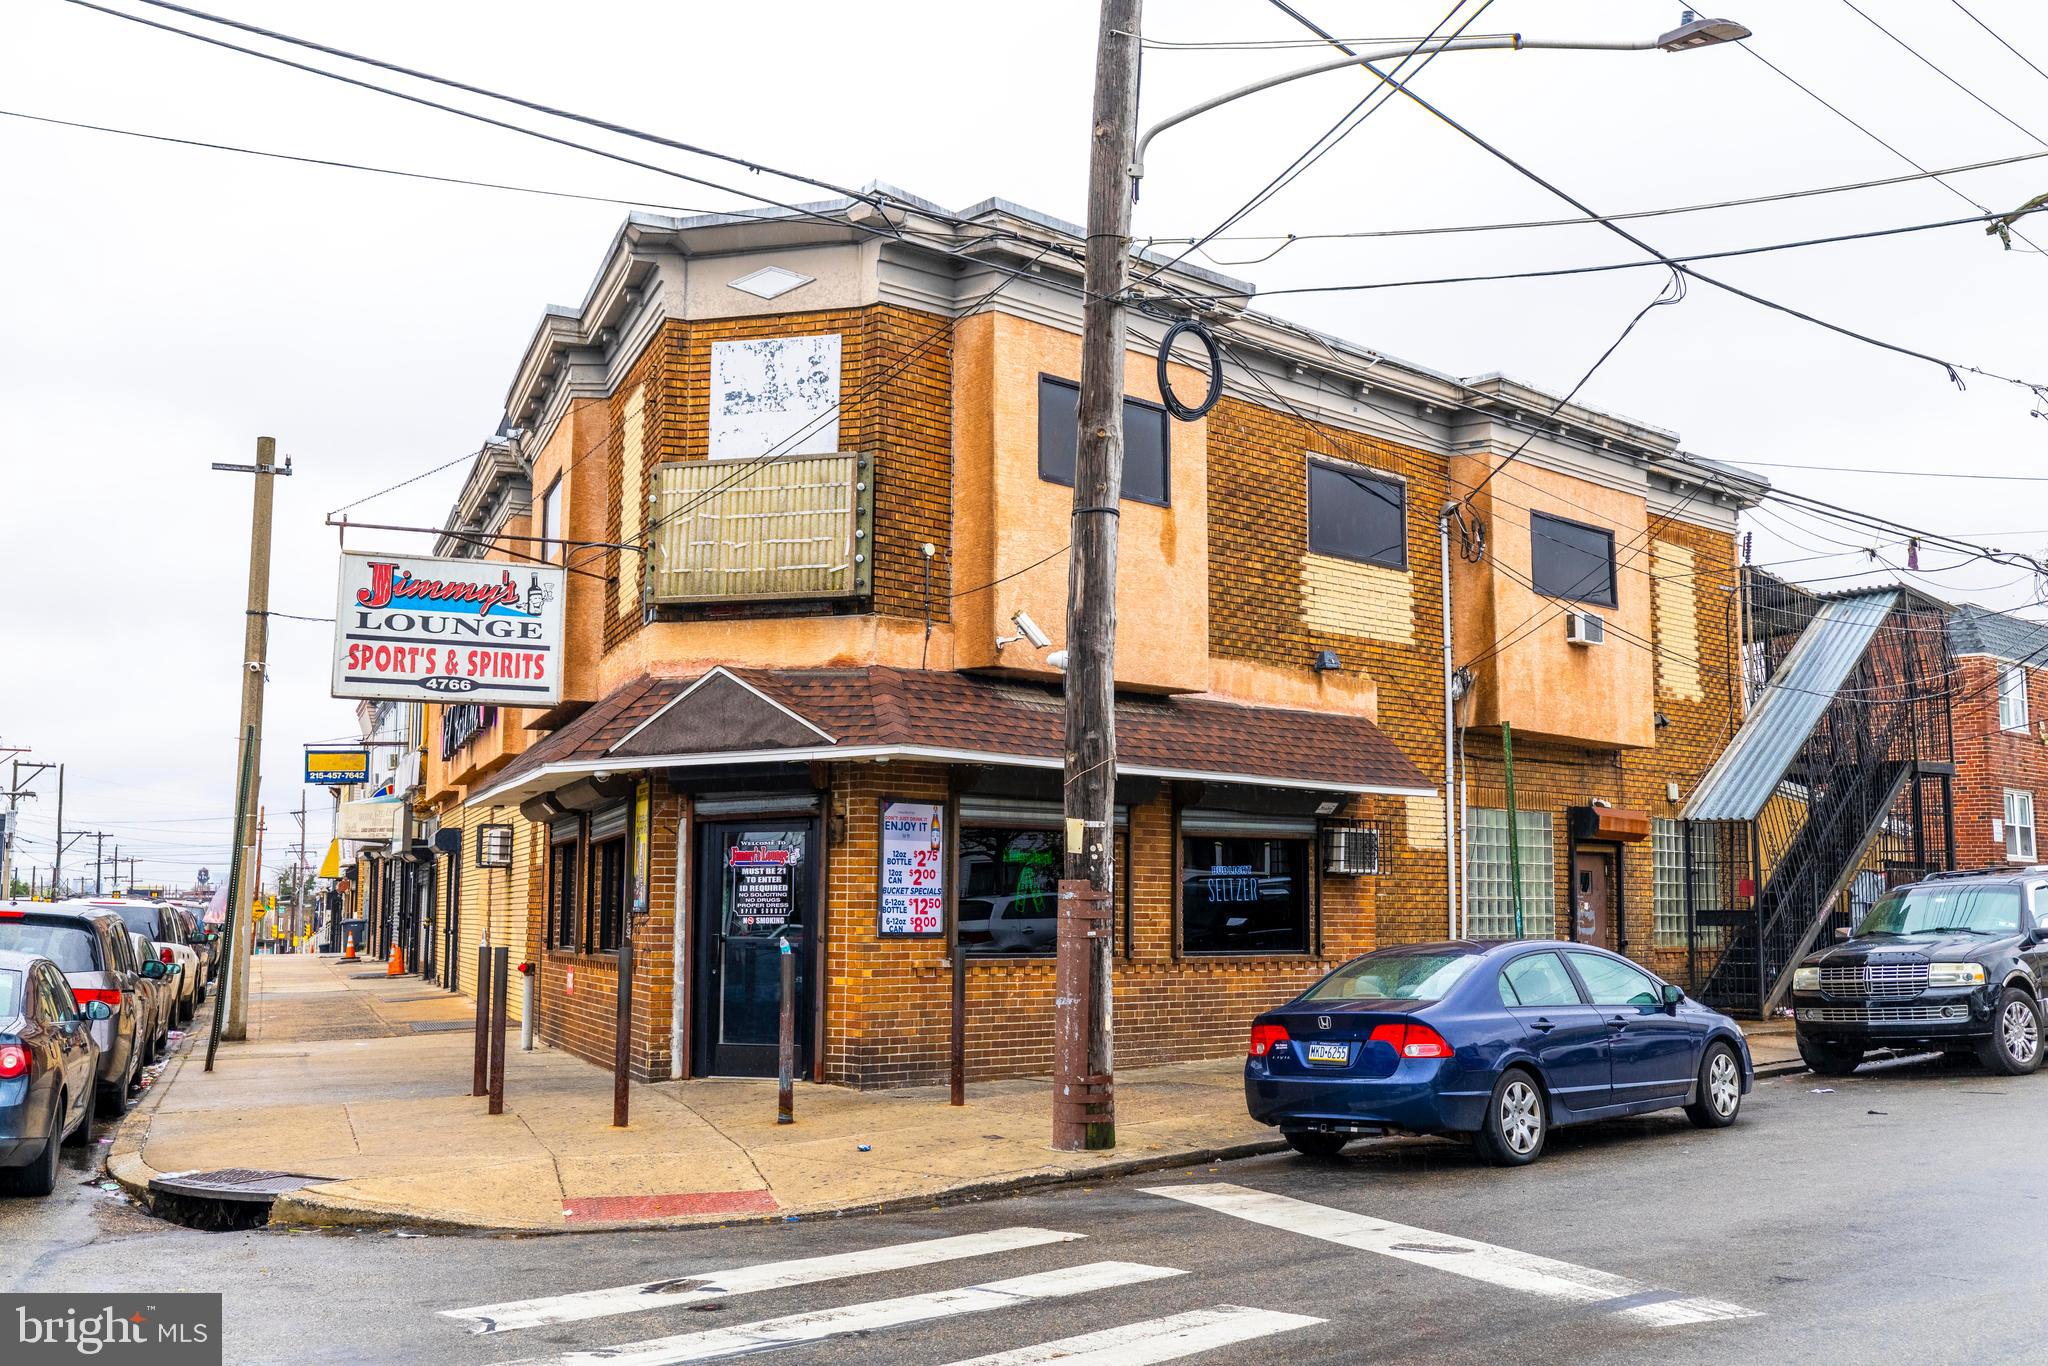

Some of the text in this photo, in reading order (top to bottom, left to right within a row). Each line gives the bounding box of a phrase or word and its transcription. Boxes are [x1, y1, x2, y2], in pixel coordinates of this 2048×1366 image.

[357, 561, 520, 617] Jimmy's
[355, 611, 543, 640] LOUNGE
[347, 643, 545, 681] SPORT'S & SPIRITS
[425, 679, 472, 692] 4766
[884, 821, 928, 832] ENJOY IT
[892, 850, 907, 858] 12oz
[886, 858, 912, 866] BOTTLE
[741, 867, 787, 875] MUST BE 21
[888, 869, 903, 877] 12oz
[739, 884, 788, 893] ID REQUIRED
[882, 886, 943, 896] BUCKET SPECIALS
[1208, 877, 1258, 902] SELTZER
[884, 898, 906, 906] 6-12oz
[882, 906, 907, 914] BOTTLE
[885, 917, 907, 925] 6-12oz
[888, 925, 904, 933] CAN
